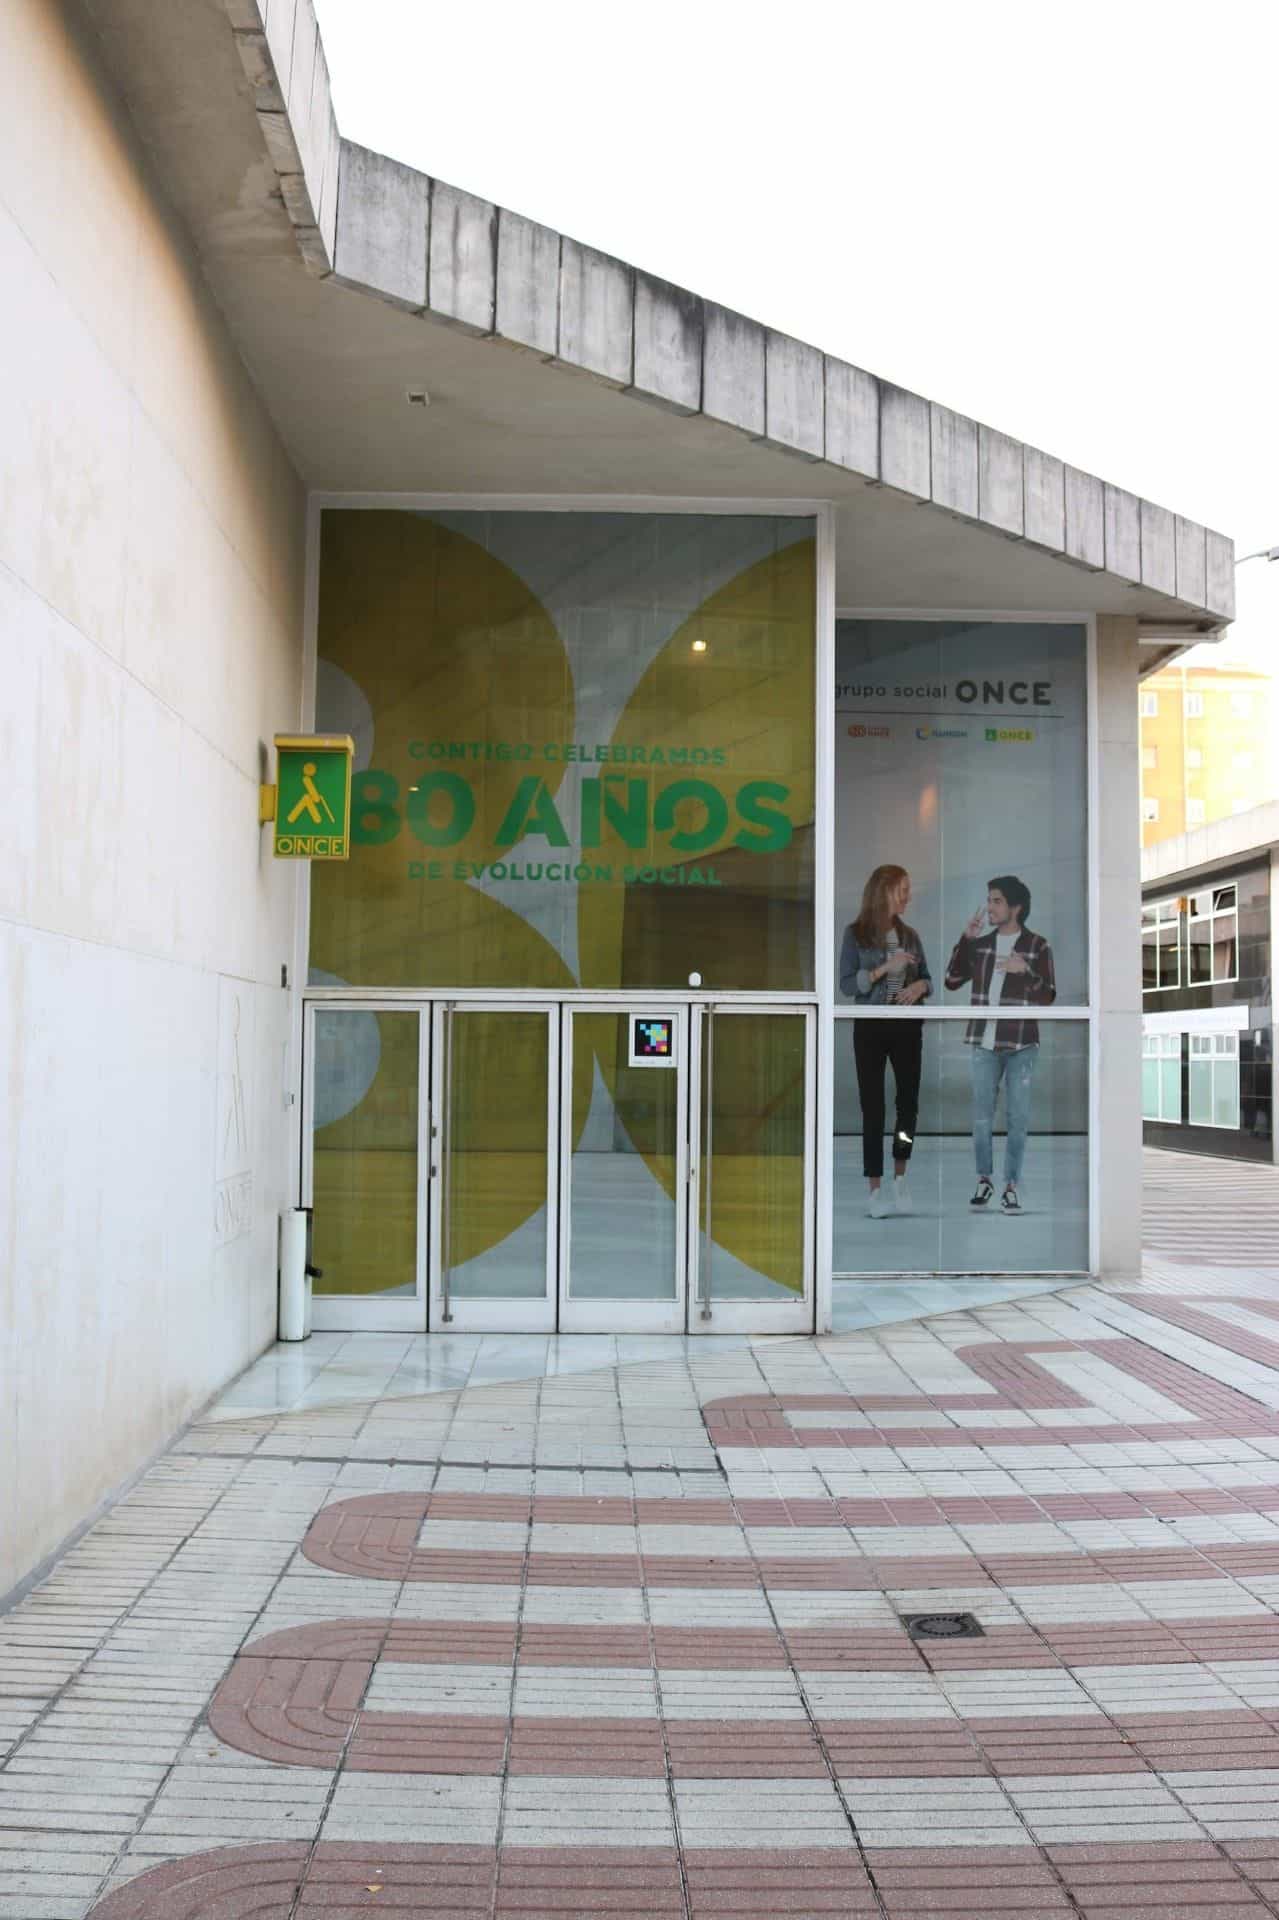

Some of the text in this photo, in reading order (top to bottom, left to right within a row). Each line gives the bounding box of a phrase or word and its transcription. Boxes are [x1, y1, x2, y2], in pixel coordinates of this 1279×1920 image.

[893, 683, 947, 698] social
[955, 680, 1053, 706] ONCE
[408, 741, 726, 766] CONTIGO CELEBRAMOS
[494, 775, 794, 854] AÑOS
[277, 838, 343, 855] ONCE
[408, 862, 443, 879] DE
[624, 866, 721, 885] SOCIAL
